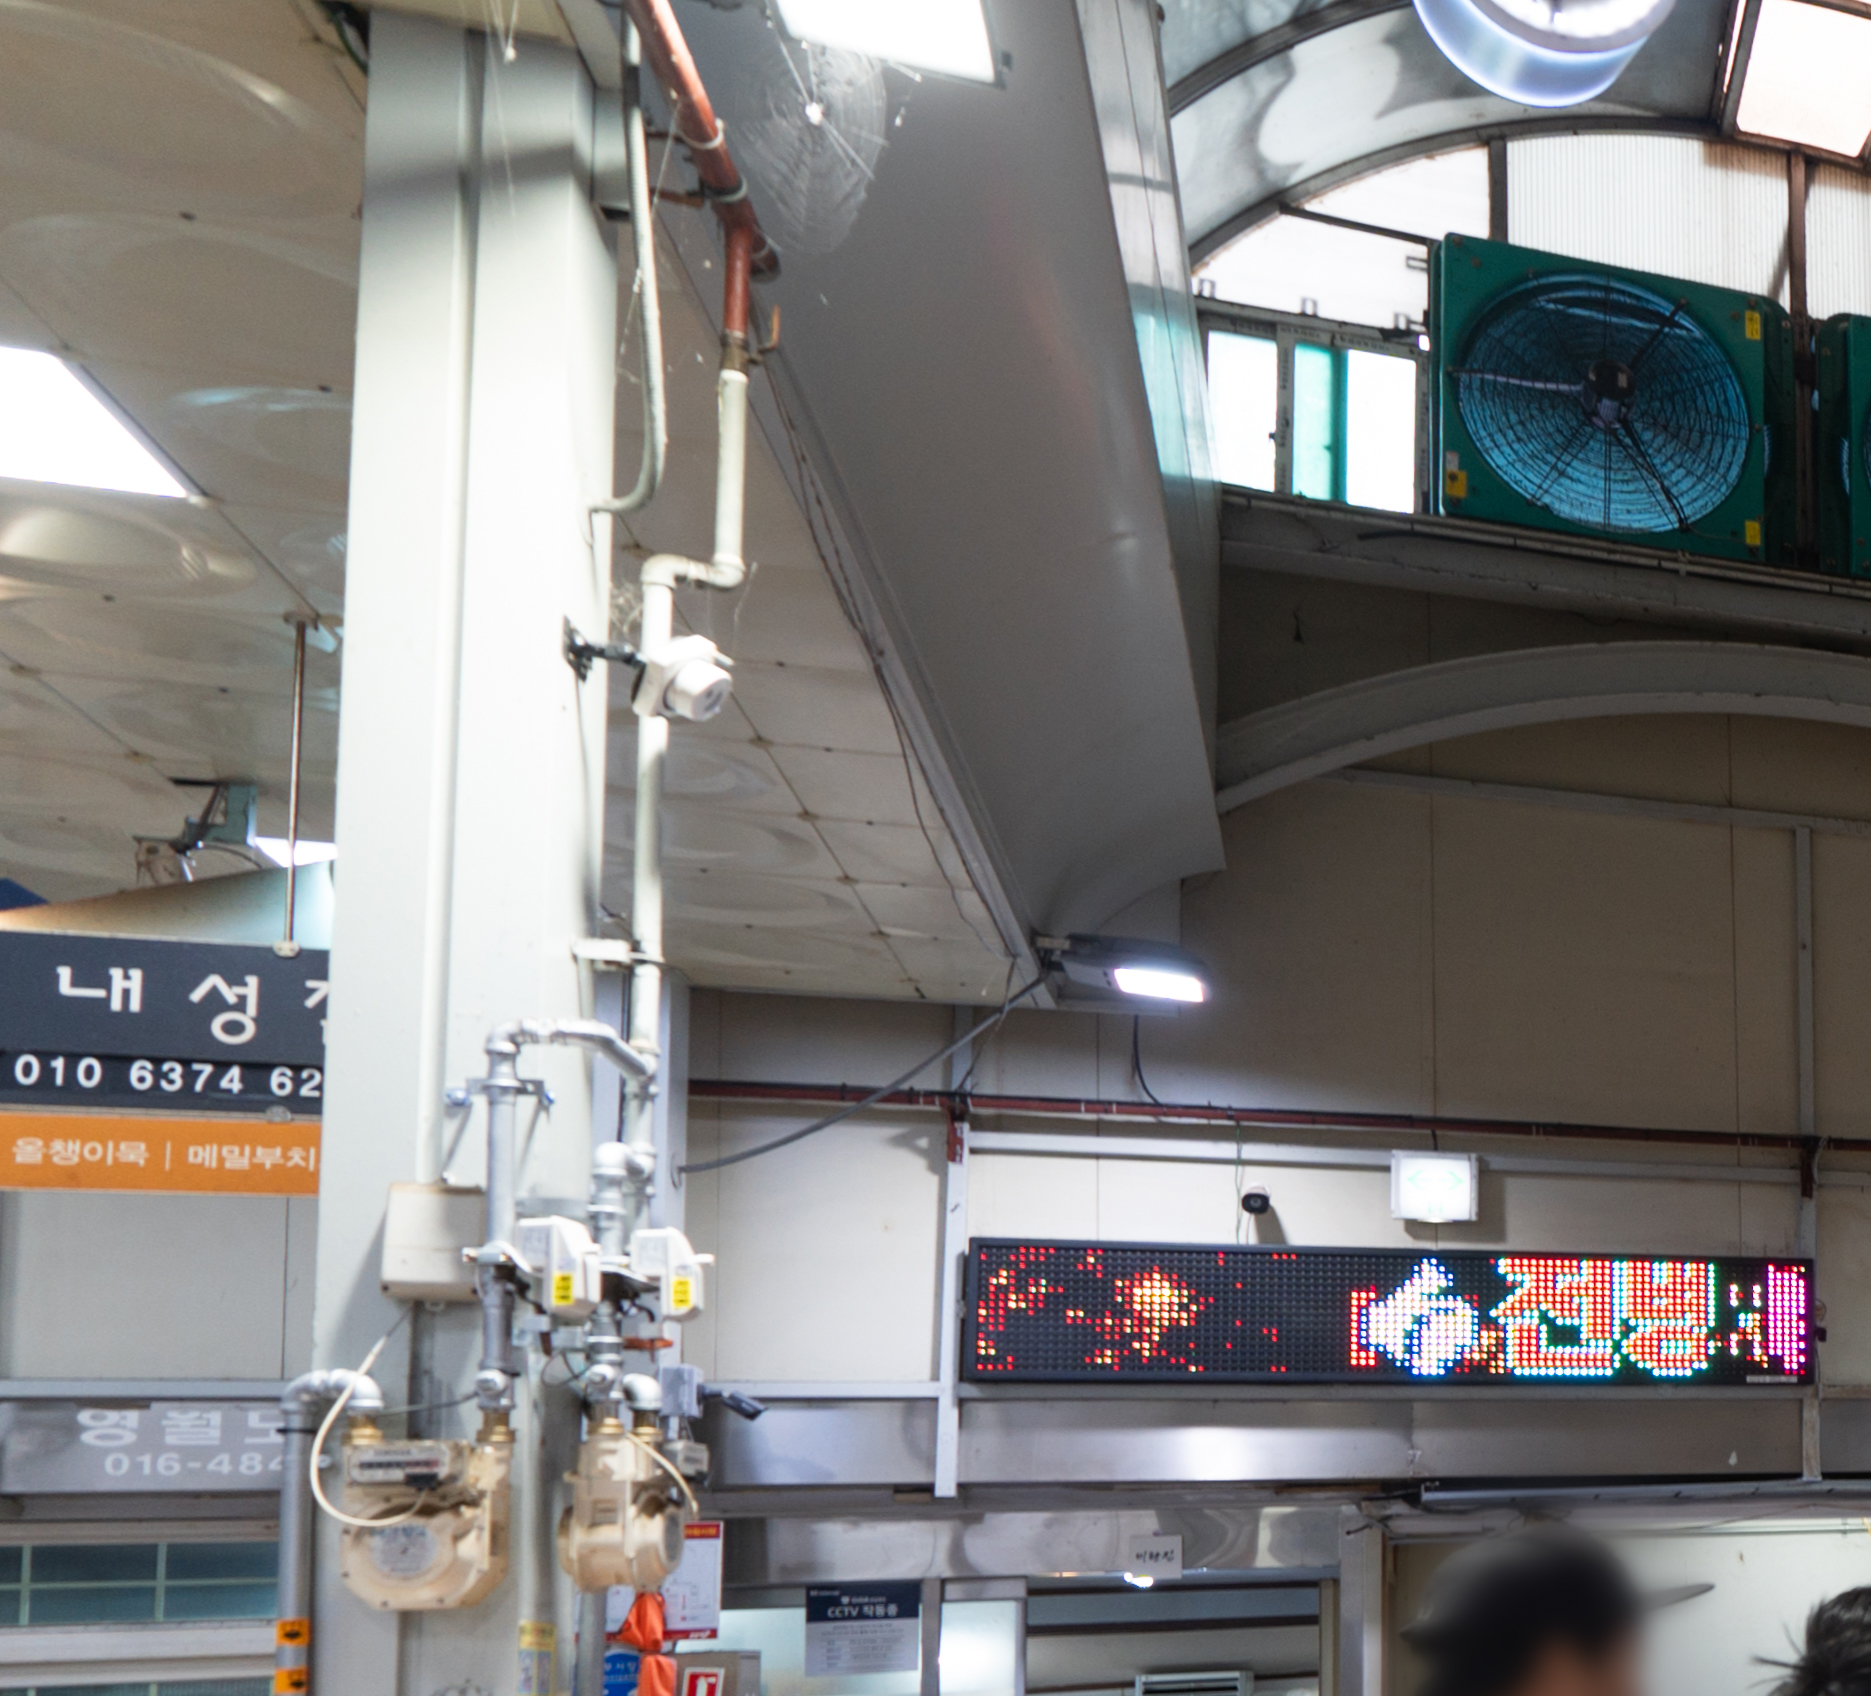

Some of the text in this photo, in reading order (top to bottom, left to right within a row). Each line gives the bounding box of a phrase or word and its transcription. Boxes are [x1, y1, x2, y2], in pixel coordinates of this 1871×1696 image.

[13, 1053, 103, 1089] 010
[128, 1058, 244, 1094] 6374
[12, 1137, 150, 1168] 올챙이묵
[827, 1605, 859, 1618] CCTV
